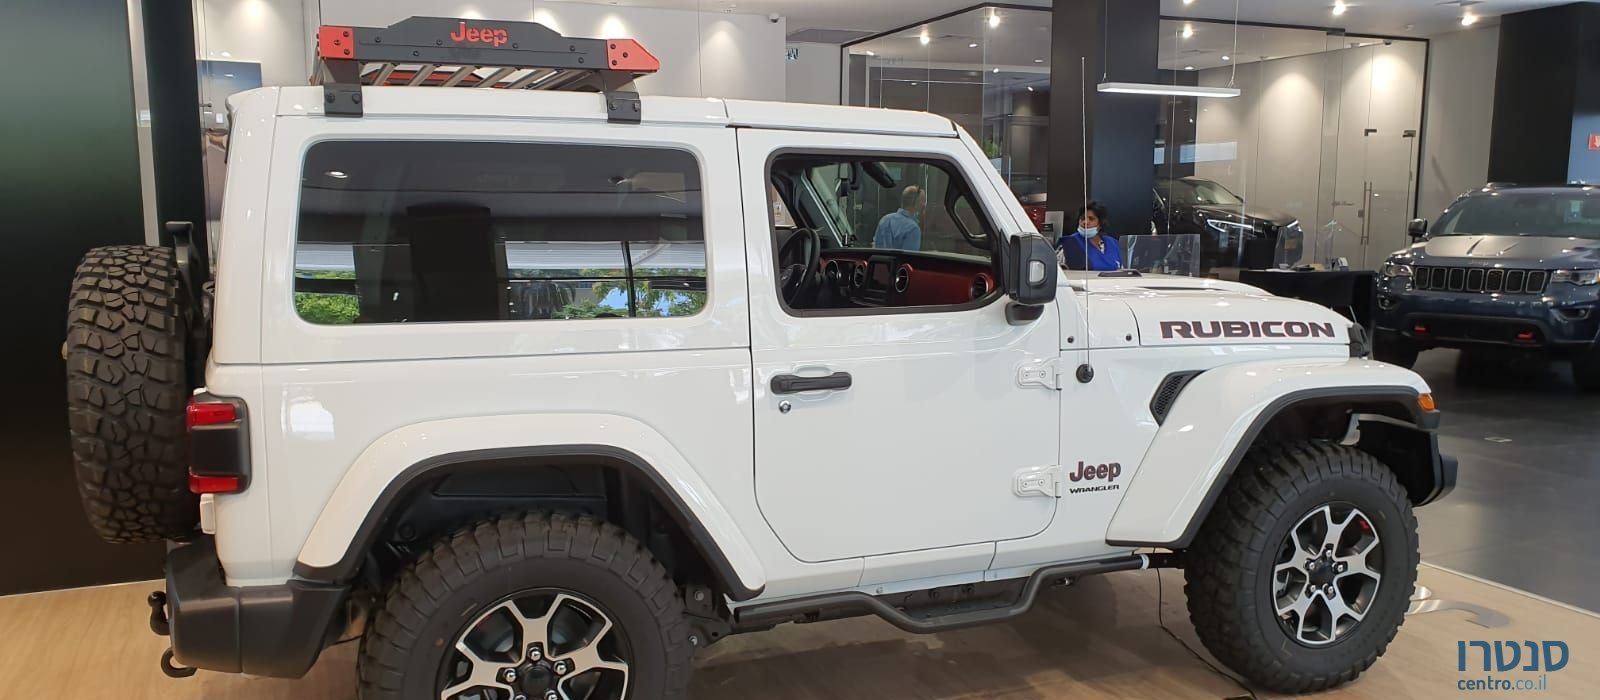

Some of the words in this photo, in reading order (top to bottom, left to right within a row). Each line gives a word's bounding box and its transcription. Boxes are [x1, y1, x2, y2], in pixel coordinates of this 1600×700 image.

[450, 21, 508, 47] Jeep
[1159, 321, 1336, 339] RUBICON
[1069, 461, 1122, 482] Jeep
[1069, 484, 1120, 494] WRANGLER
